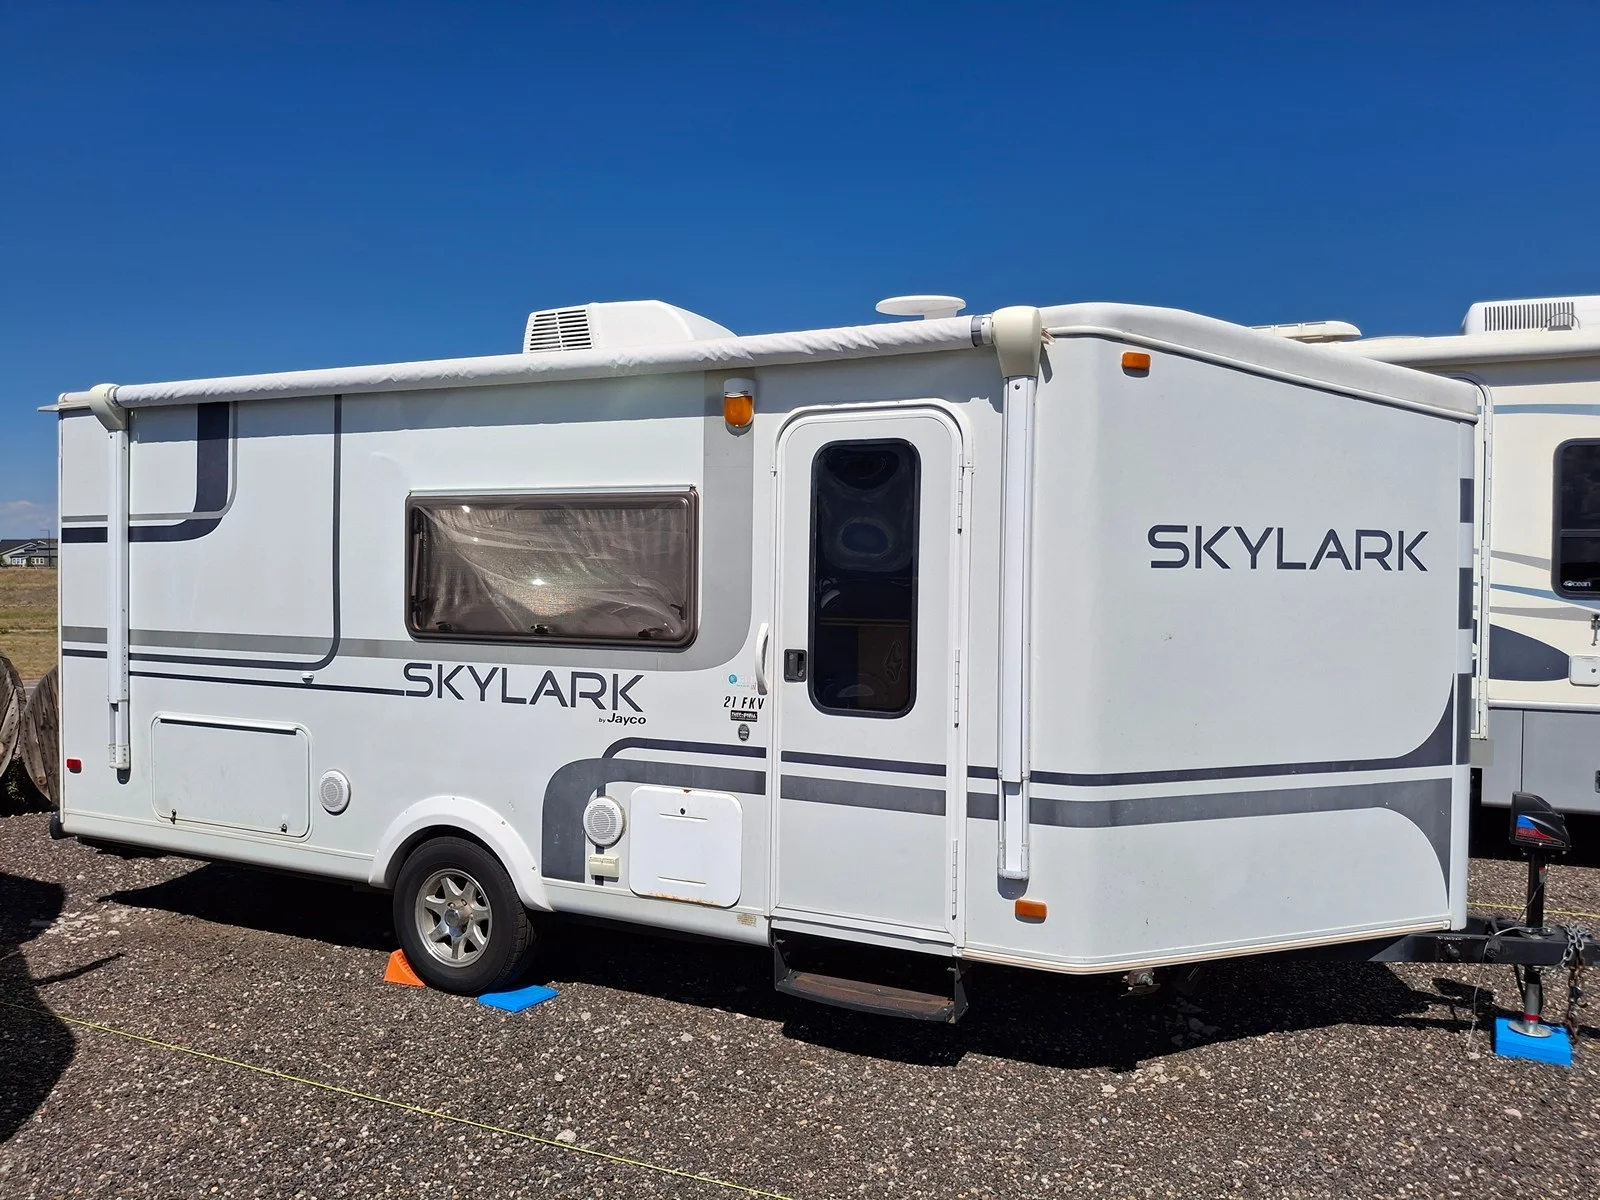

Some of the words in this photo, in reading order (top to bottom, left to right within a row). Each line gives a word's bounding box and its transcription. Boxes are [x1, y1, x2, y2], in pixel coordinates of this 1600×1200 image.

[1147, 524, 1429, 572] SKYLARK
[403, 662, 645, 713] SKYLARK
[724, 696, 736, 708] 21
[741, 697, 764, 710] FKV
[607, 712, 647, 726] Jayco
